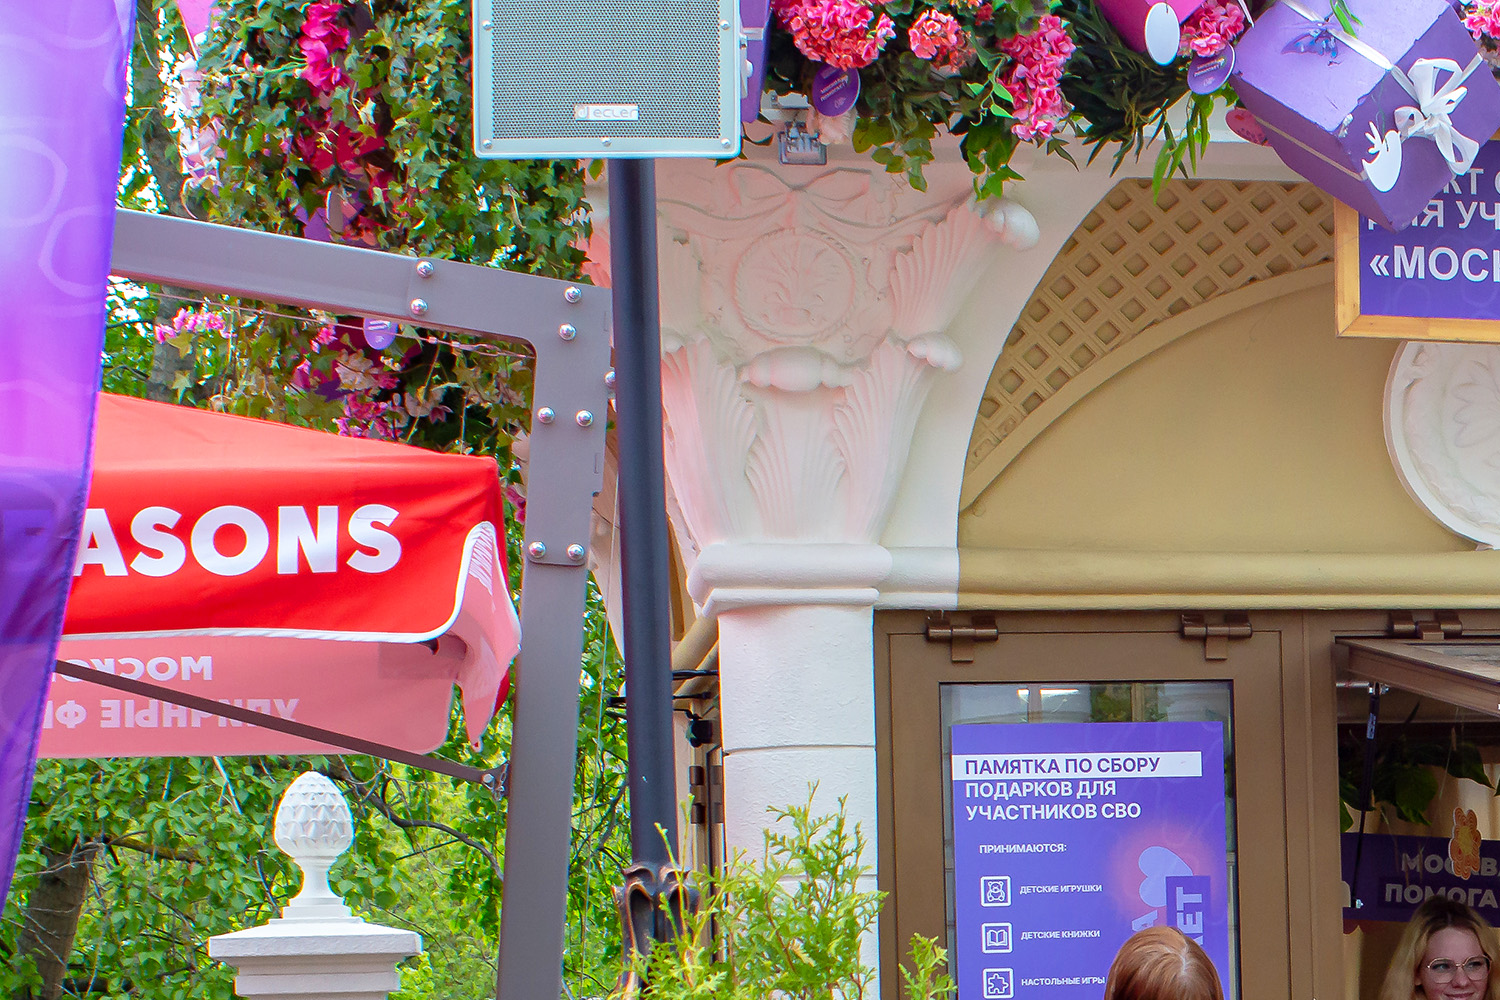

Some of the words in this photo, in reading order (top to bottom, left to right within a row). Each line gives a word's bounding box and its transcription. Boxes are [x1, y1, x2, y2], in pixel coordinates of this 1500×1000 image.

[73, 504, 402, 577] ASONS
[965, 759, 1061, 775] ПАМЯТКА
[1065, 759, 1093, 774] ПО
[1097, 757, 1161, 773] СБОРУ
[965, 781, 1073, 800] ПОДАРКОВ
[1077, 780, 1117, 799] ДЛЯ
[966, 803, 1098, 820] УЧАСТНИКОВ
[1101, 802, 1142, 819] СВО
[979, 843, 1068, 854] ПРИНИМАЮТСЯ:
[1020, 885, 1059, 895] ДЕТСКИЕ
[1060, 884, 1102, 893] ИГРУШКИ
[1021, 931, 1060, 940] ДЕТСКИЕ
[1061, 930, 1100, 938] КНИЖКИ
[1021, 977, 1080, 986] НАСТОЛЬНЫЕ
[1081, 976, 1105, 984] ИГРЫ
